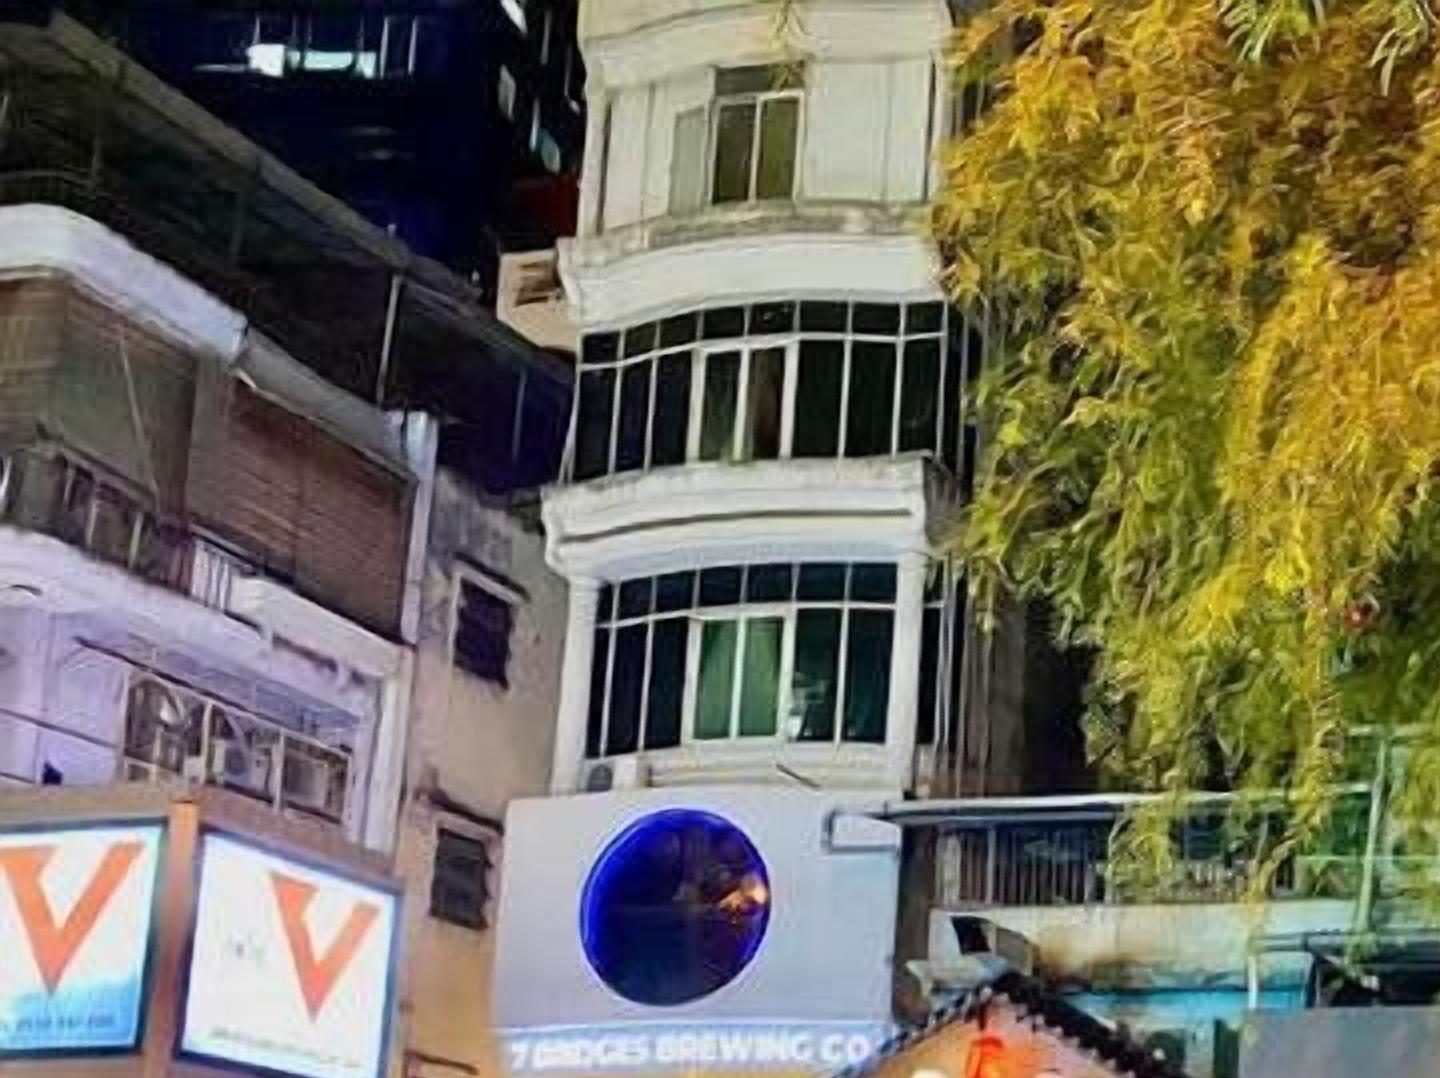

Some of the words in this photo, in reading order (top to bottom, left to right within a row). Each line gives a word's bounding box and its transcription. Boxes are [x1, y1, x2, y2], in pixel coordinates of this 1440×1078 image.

[510, 1043, 526, 1070] 7
[531, 1037, 648, 1069] BRIDGES
[655, 1031, 813, 1063] BREWING
[820, 1032, 871, 1064] CO
